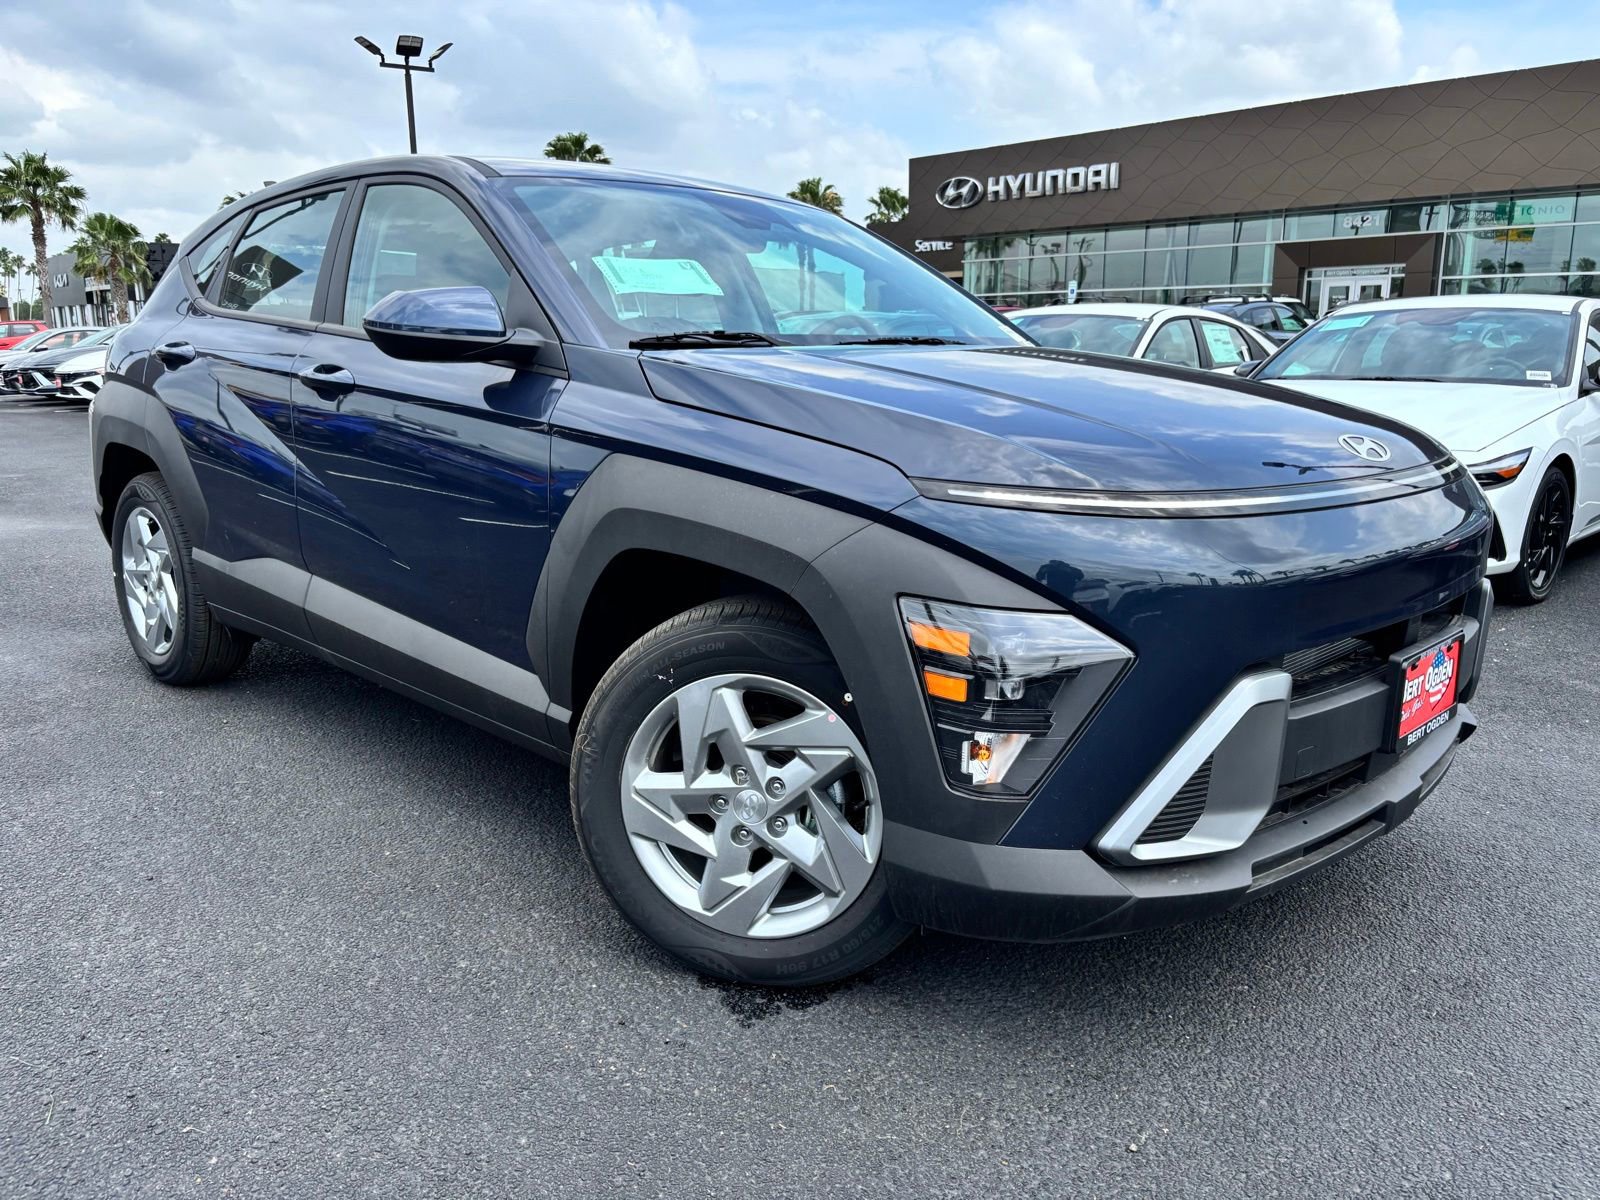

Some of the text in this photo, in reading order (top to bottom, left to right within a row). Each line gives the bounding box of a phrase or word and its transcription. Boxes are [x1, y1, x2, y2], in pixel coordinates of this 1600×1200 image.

[987, 162, 1120, 201] HYUNDAI
[1343, 214, 1380, 229] 8421
[914, 239, 954, 252] Service
[1407, 711, 1450, 746] BERT OGDEN
